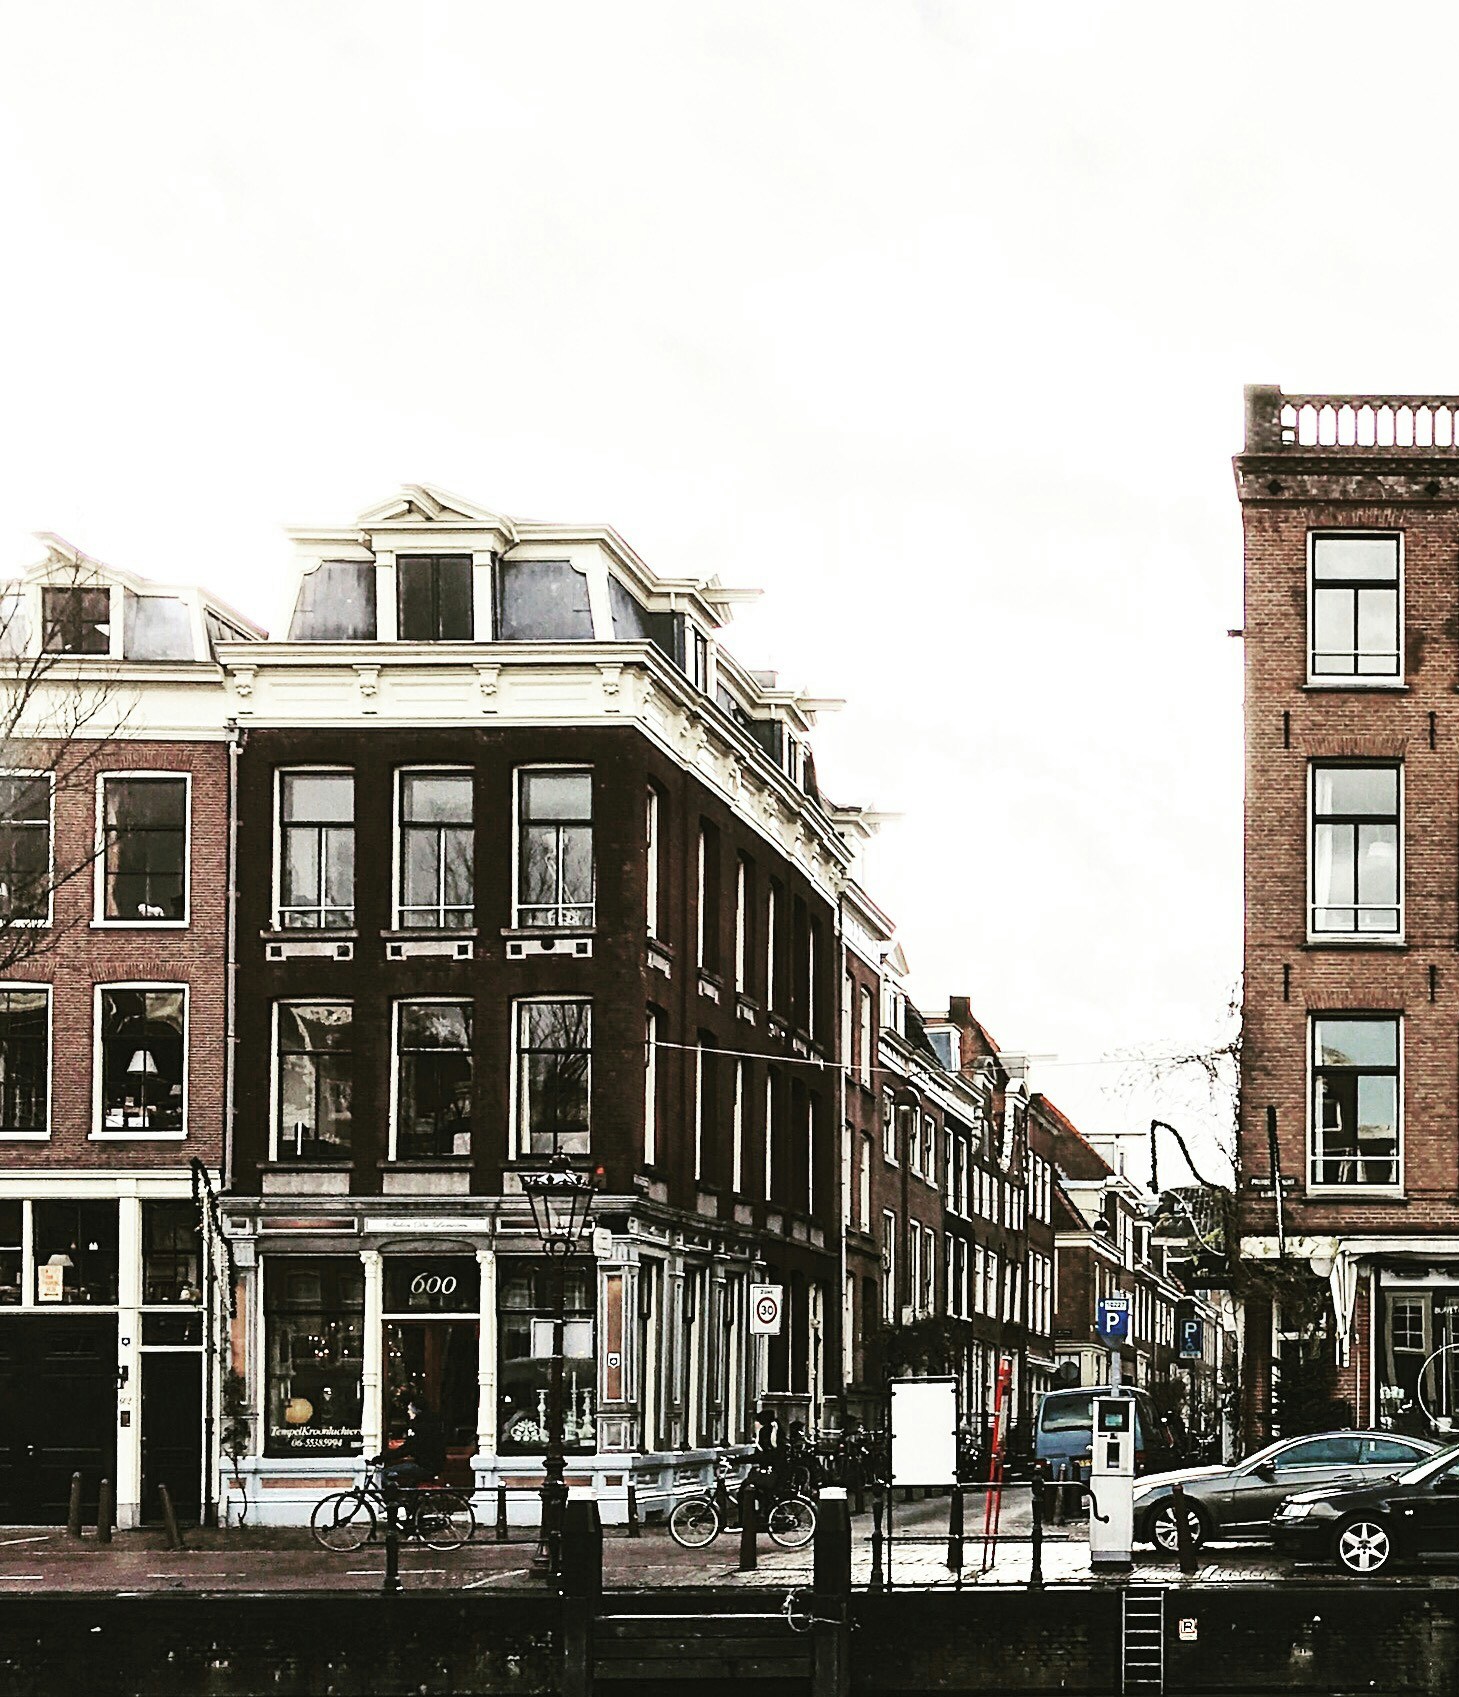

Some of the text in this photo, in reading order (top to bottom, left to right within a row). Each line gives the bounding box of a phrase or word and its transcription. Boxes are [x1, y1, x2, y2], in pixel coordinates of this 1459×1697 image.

[411, 1272, 457, 1294] 600
[761, 1305, 774, 1315] 30
[1106, 1312, 1120, 1333] P
[1184, 1322, 1197, 1338] P
